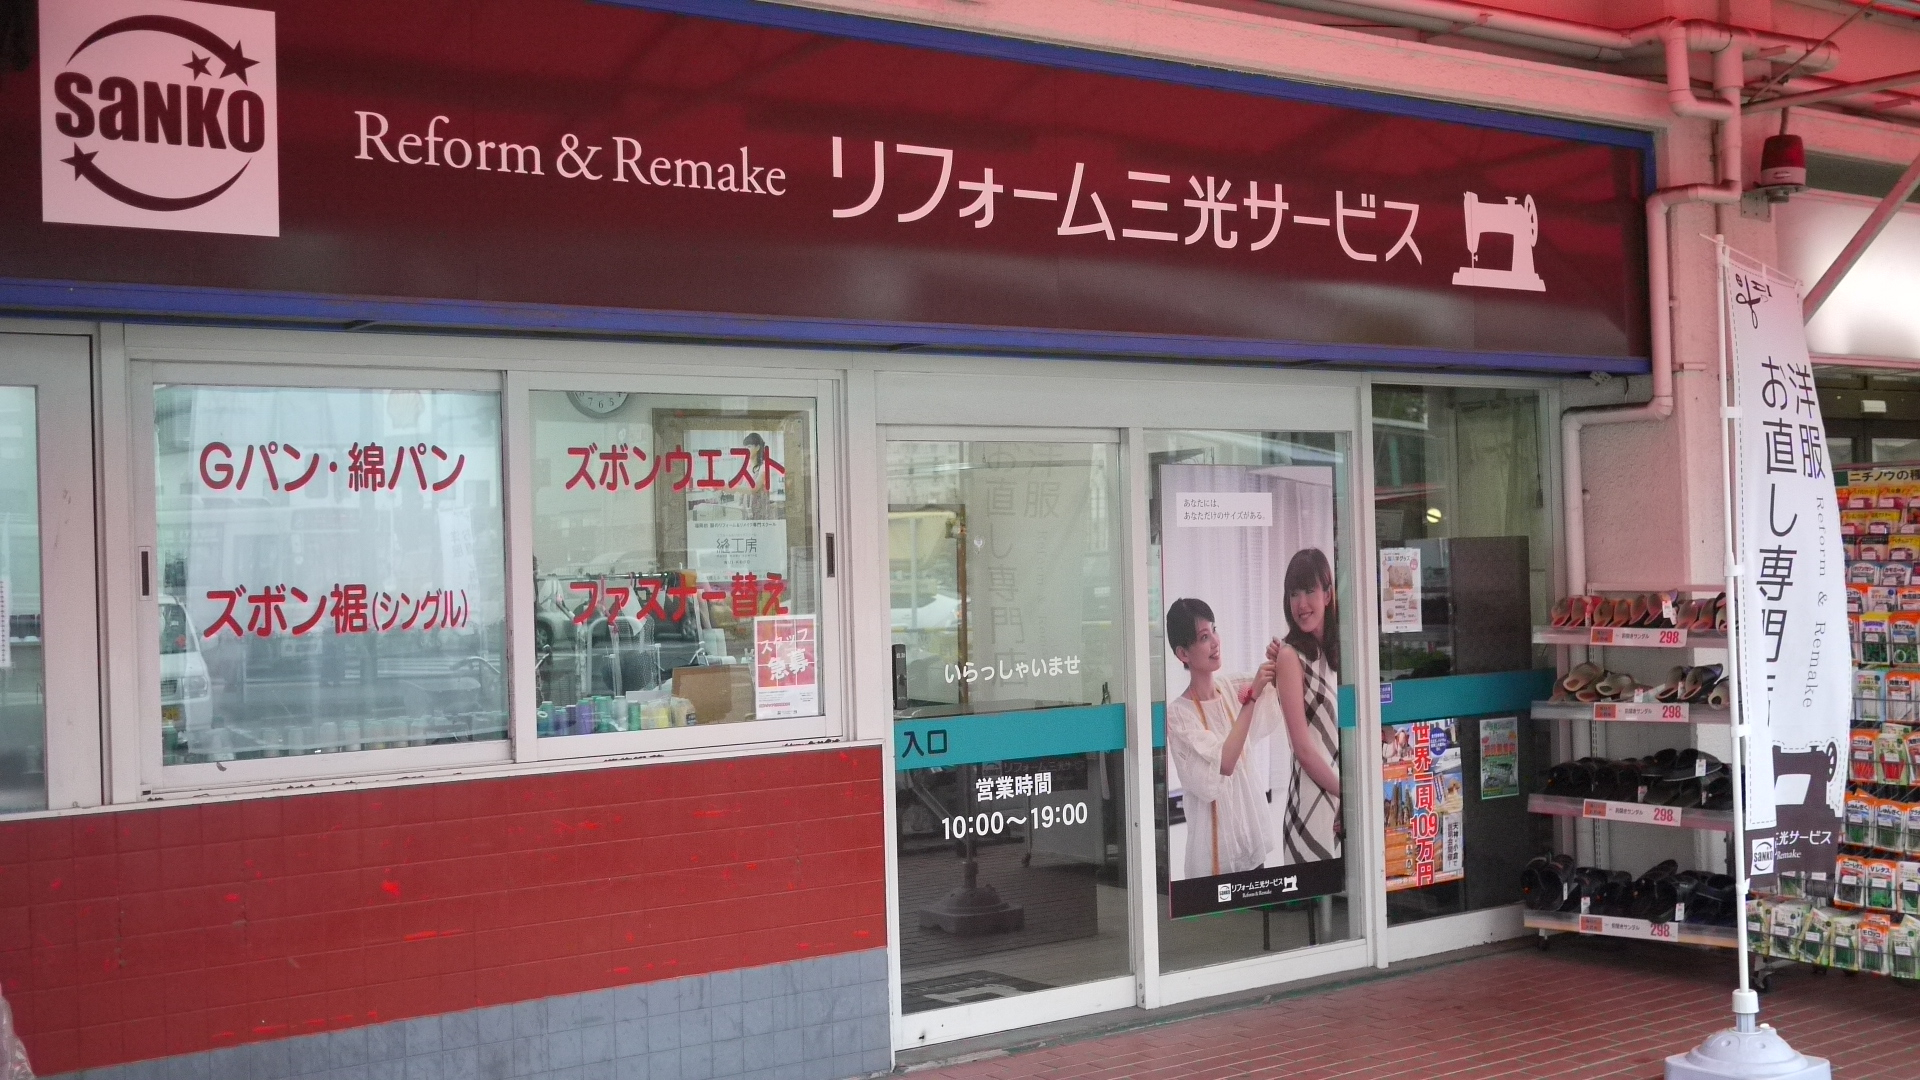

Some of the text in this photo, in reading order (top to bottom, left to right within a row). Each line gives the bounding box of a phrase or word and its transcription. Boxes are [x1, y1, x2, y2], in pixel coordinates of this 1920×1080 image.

[354, 110, 787, 197] Reform & Remake
[832, 136, 1422, 266] リフォーム三光サービス
[1787, 363, 1826, 479] 洋服
[200, 441, 465, 492] Gパン・綿パン
[565, 442, 786, 492] ズボンウエスト
[569, 572, 789, 626] ファスナー替え
[1803, 495, 1828, 708] Reform & Remake
[760, 628, 808, 655] スタッフ
[1659, 630, 1680, 644] 298
[767, 648, 810, 681] 急募
[944, 655, 1081, 684] いらっしゃいませ
[1662, 705, 1682, 719] 298
[901, 729, 949, 760] 入口
[976, 771, 1053, 802] 営業時間
[1653, 807, 1674, 822] 298
[1650, 922, 1671, 937] 298
